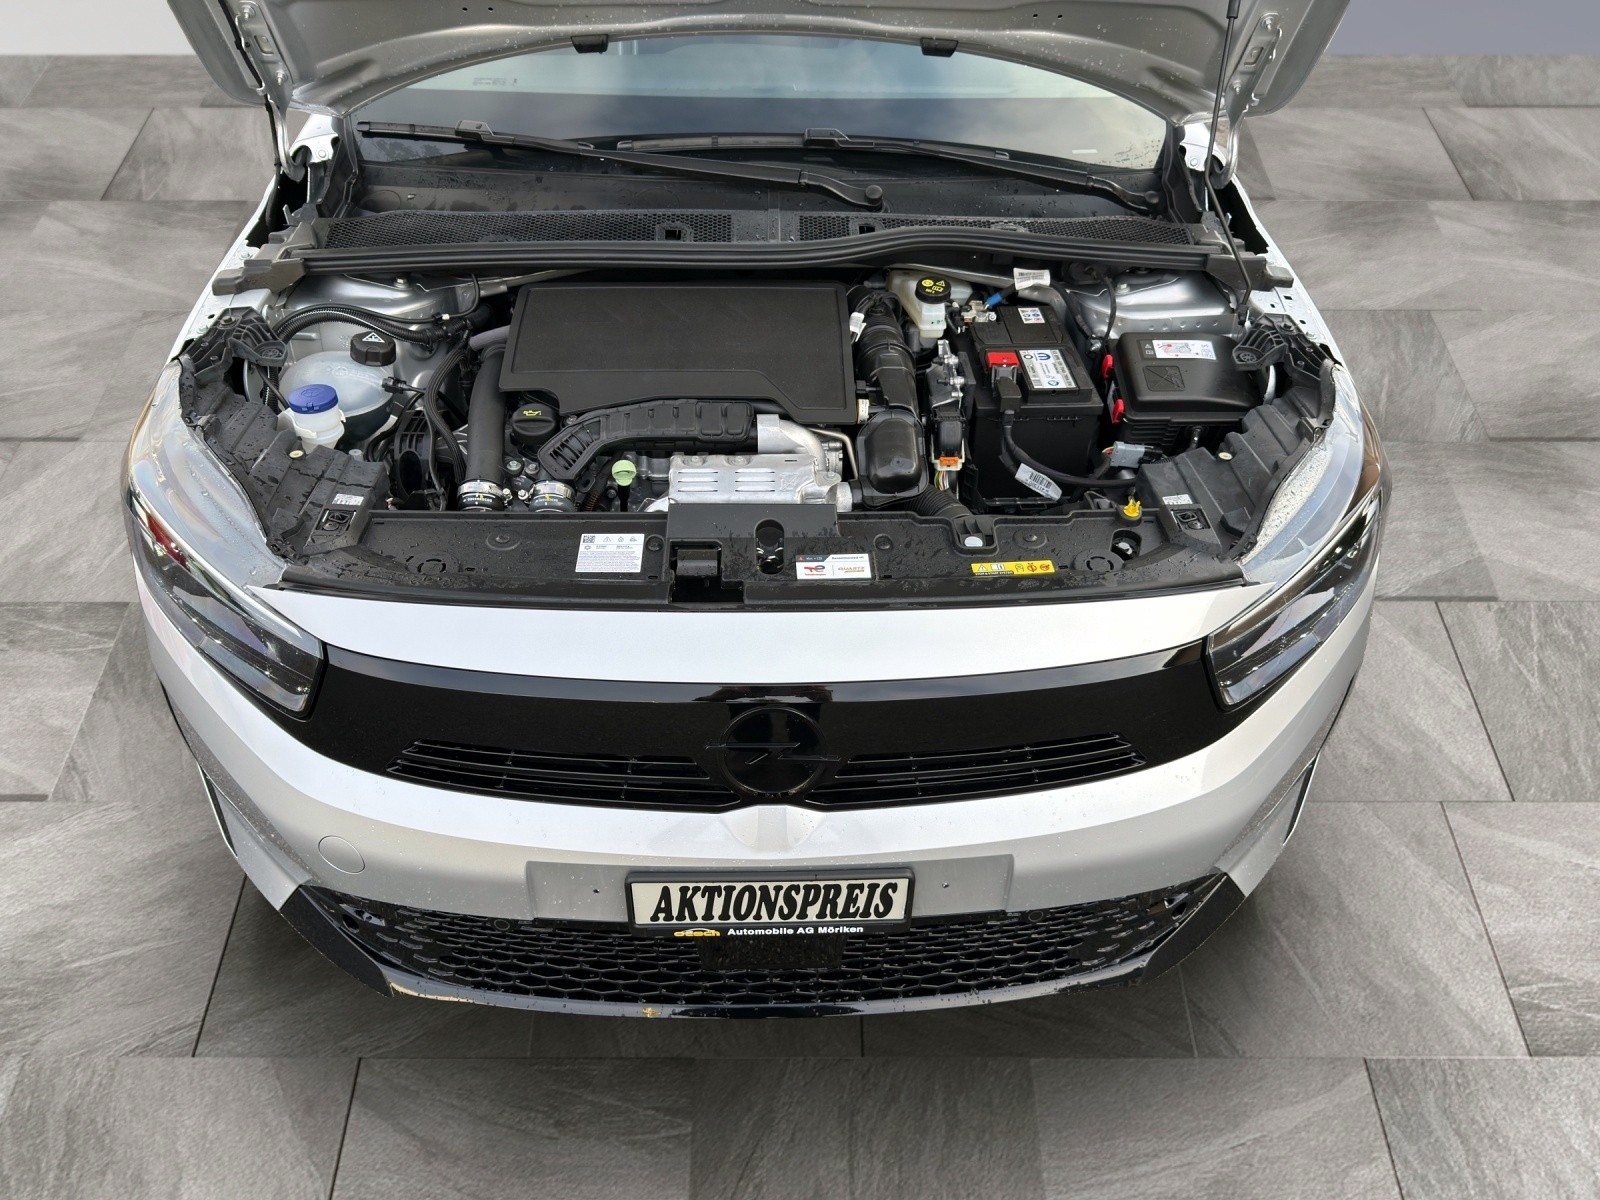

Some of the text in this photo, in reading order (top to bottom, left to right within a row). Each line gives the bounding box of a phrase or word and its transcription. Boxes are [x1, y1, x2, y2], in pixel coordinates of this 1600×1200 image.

[650, 882, 898, 922] AKTIONSPREIS
[727, 927, 794, 936] Automobile
[797, 926, 814, 935] AG
[818, 925, 864, 934] Möriken
